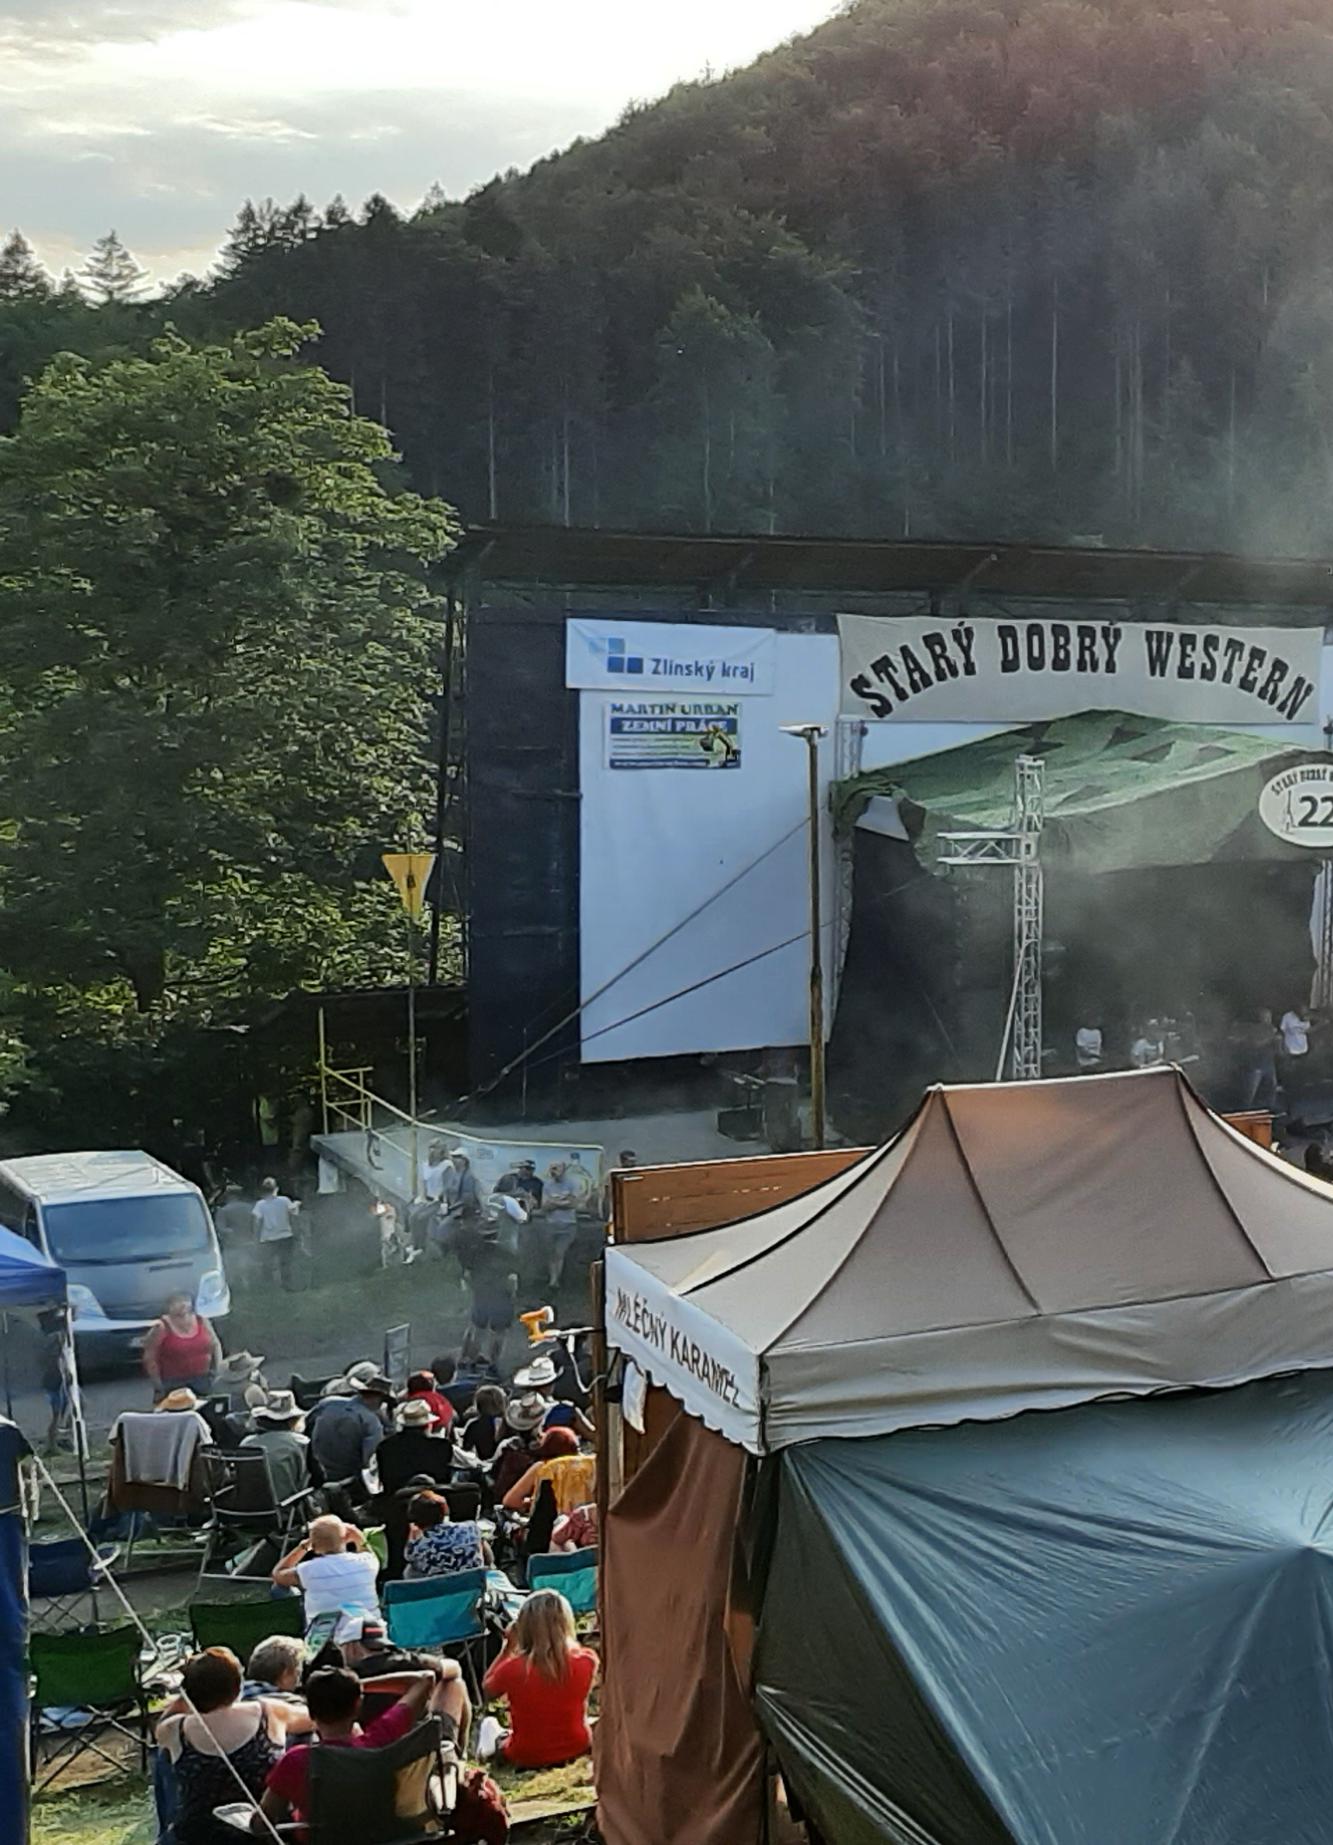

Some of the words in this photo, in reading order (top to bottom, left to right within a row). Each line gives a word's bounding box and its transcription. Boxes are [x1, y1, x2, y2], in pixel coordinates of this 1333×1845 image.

[651, 657, 716, 682] Zlínský
[721, 660, 755, 683] kraj
[850, 621, 976, 719] STARÝ
[997, 620, 1123, 675] DOBRÝ
[1145, 628, 1315, 721] WESTERN
[610, 703, 676, 716] MARTIN
[681, 703, 738, 716] URBAN
[621, 718, 672, 732] ZEMNÍ
